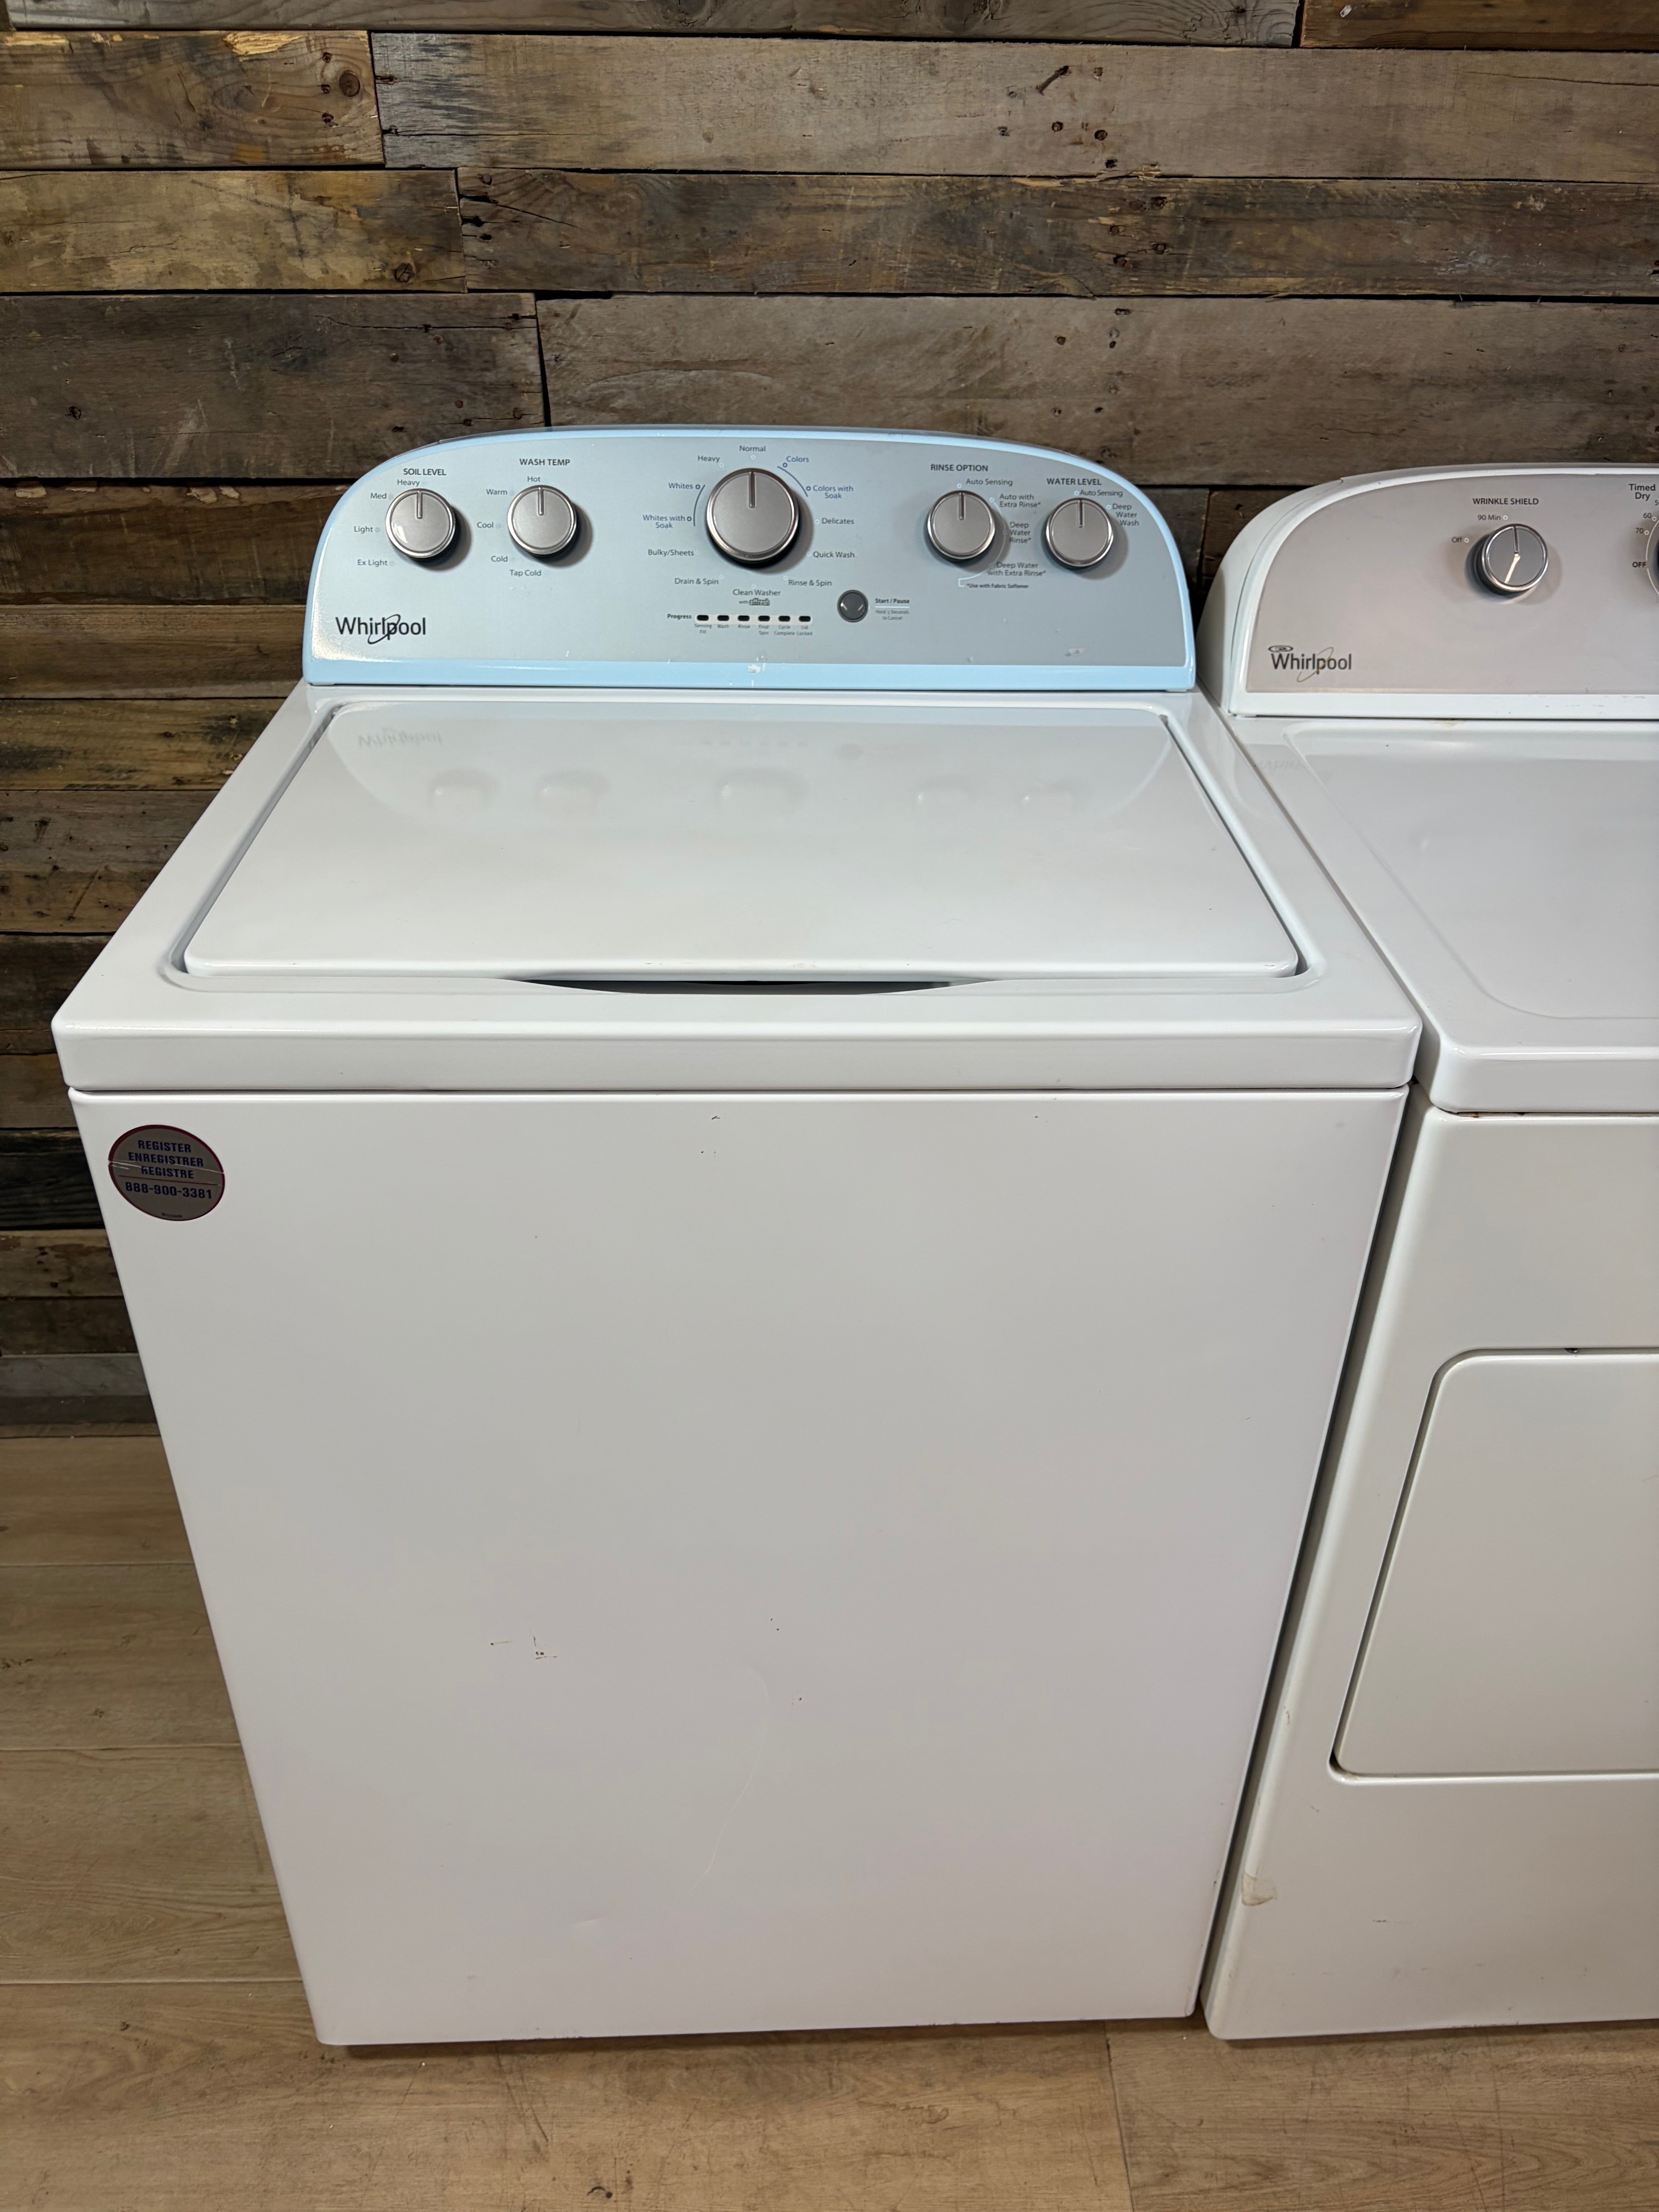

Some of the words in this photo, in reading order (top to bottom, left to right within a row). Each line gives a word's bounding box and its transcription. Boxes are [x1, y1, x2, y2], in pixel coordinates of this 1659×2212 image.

[1635, 493, 1650, 501] Dry
[335, 617, 426, 640] Whirlpool
[1271, 653, 1352, 675] Whirlpool
[138, 1140, 191, 1152] REGISTER
[128, 1152, 203, 1167] ENREGISTRER
[141, 1166, 194, 1179] REGISTRE
[125, 1182, 211, 1199] 888-900-3381
